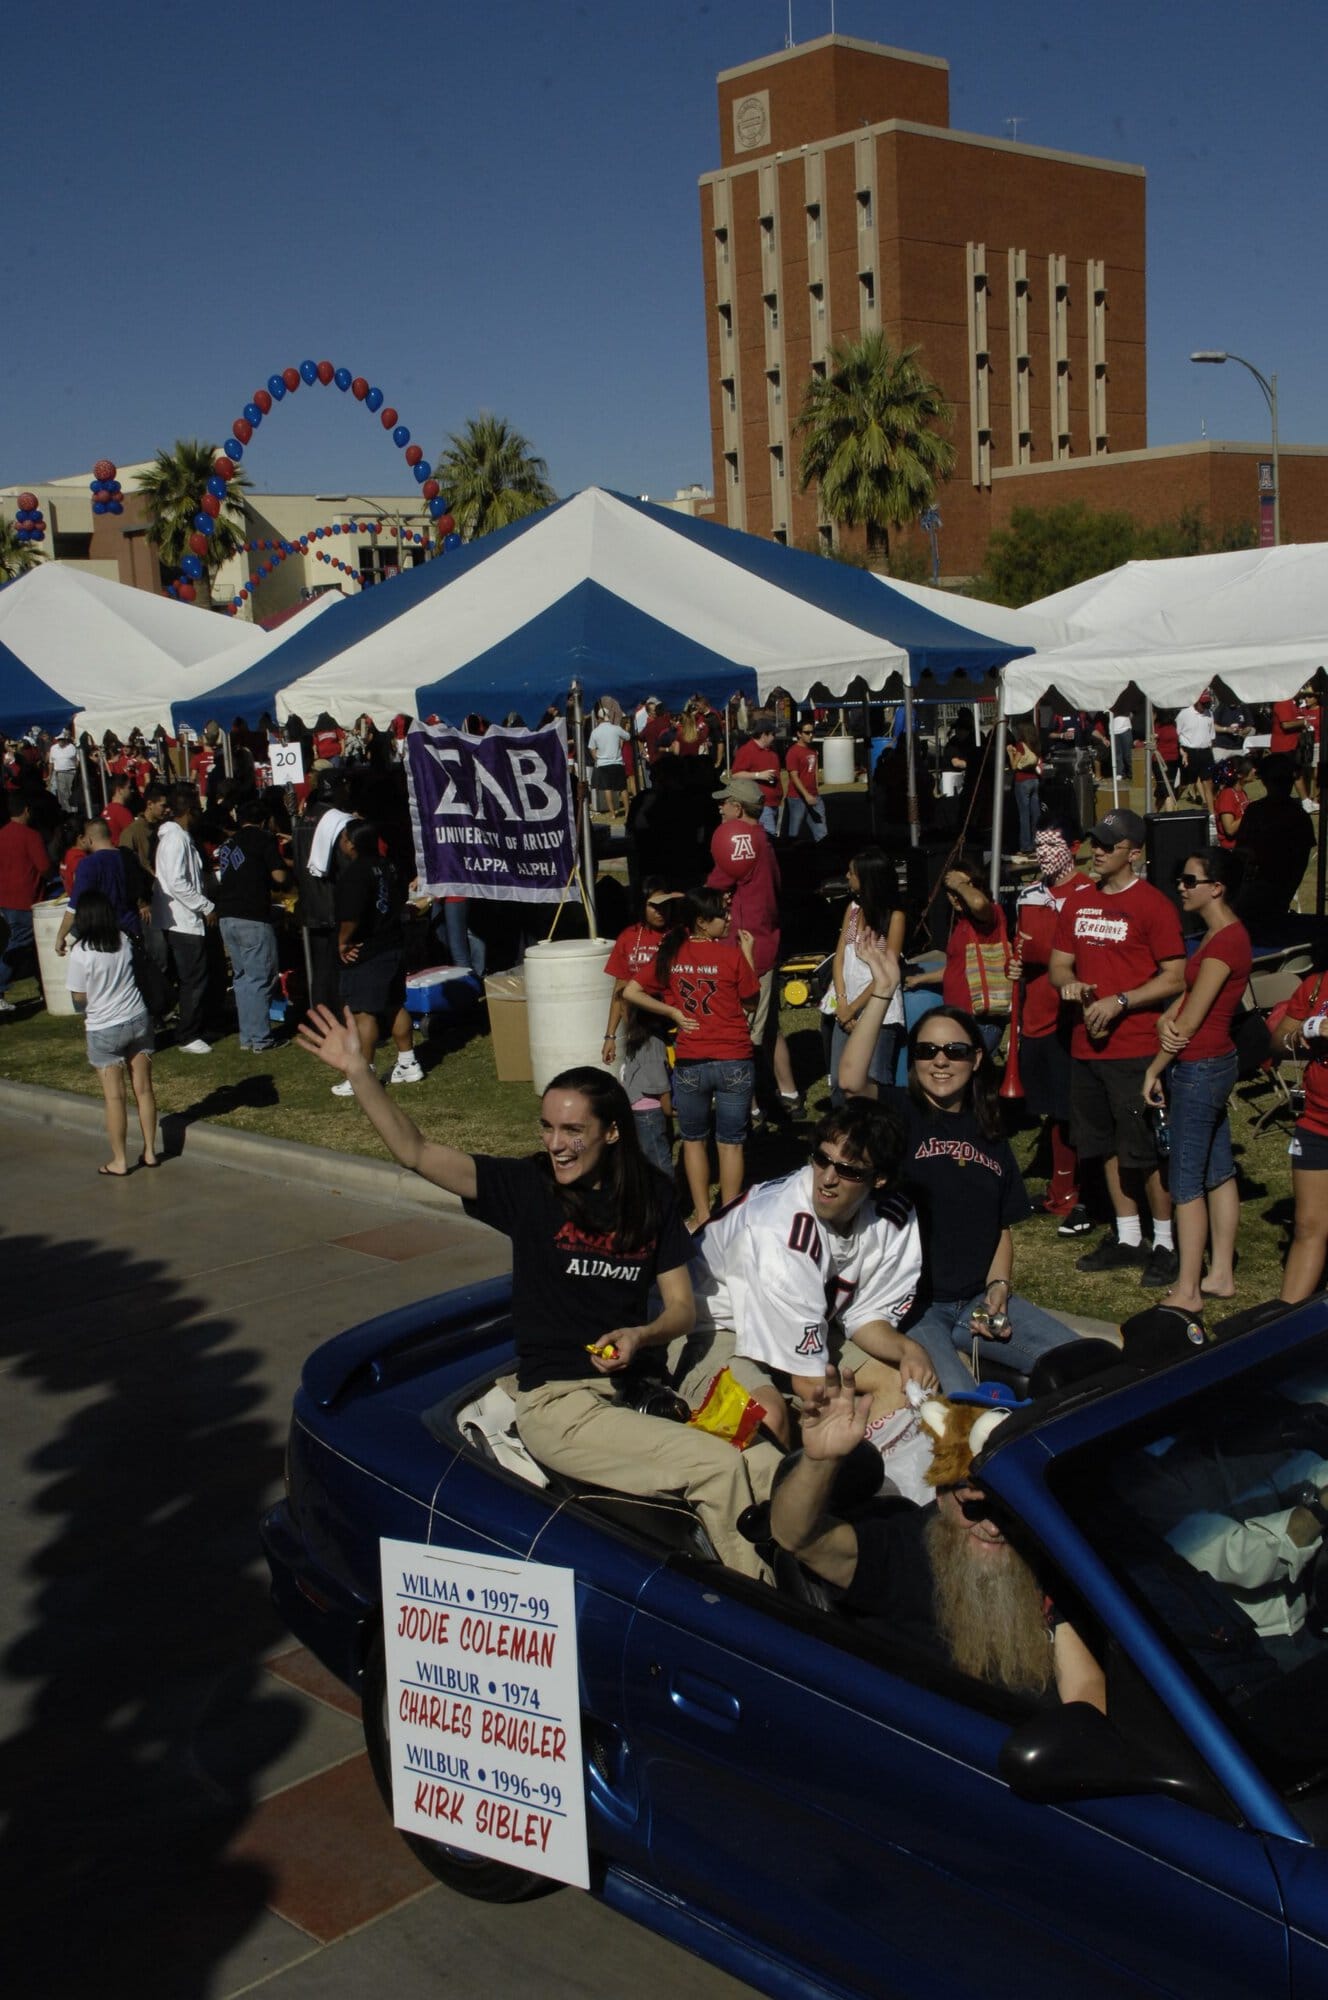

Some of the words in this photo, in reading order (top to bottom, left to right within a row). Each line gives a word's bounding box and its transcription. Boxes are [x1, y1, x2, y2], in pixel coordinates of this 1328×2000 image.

[276, 752, 296, 767] 20
[435, 826, 500, 849] UNIVERSTY
[505, 836, 519, 850] OF
[731, 834, 756, 860] A
[463, 856, 509, 873] KAPPA
[516, 861, 558, 876] ALPHA
[565, 1258, 641, 1282] ALUMNI
[795, 1324, 823, 1355] A
[402, 1572, 460, 1603] WILMA
[480, 1588, 550, 1620] 1997-99
[398, 1605, 450, 1644] JODIE
[459, 1617, 556, 1669] COLEMAN
[416, 1661, 480, 1695] WILBUR
[502, 1682, 541, 1710] 1974
[399, 1689, 472, 1739] CHARLES
[482, 1709, 566, 1762] BRUGLER
[406, 1744, 470, 1781] WILBUR
[491, 1769, 562, 1808] 1996-99
[414, 1781, 465, 1825] KIRK
[476, 1799, 552, 1853] SIBLEY
